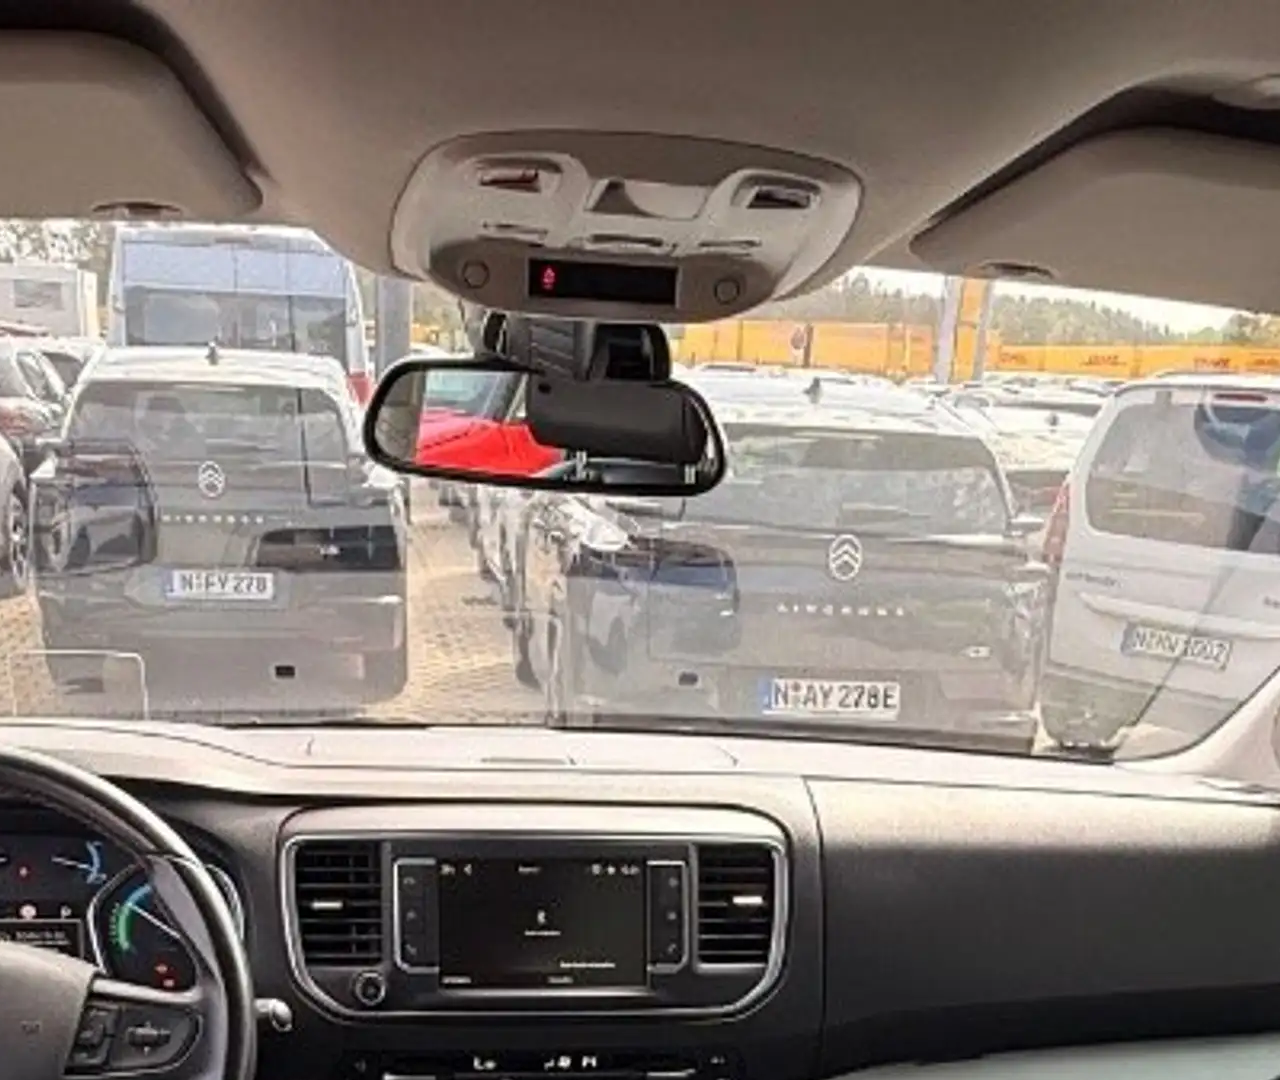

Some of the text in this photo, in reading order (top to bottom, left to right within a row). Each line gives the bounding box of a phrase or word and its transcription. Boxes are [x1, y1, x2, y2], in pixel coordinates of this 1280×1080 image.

[774, 681, 898, 709] N AY 278E
